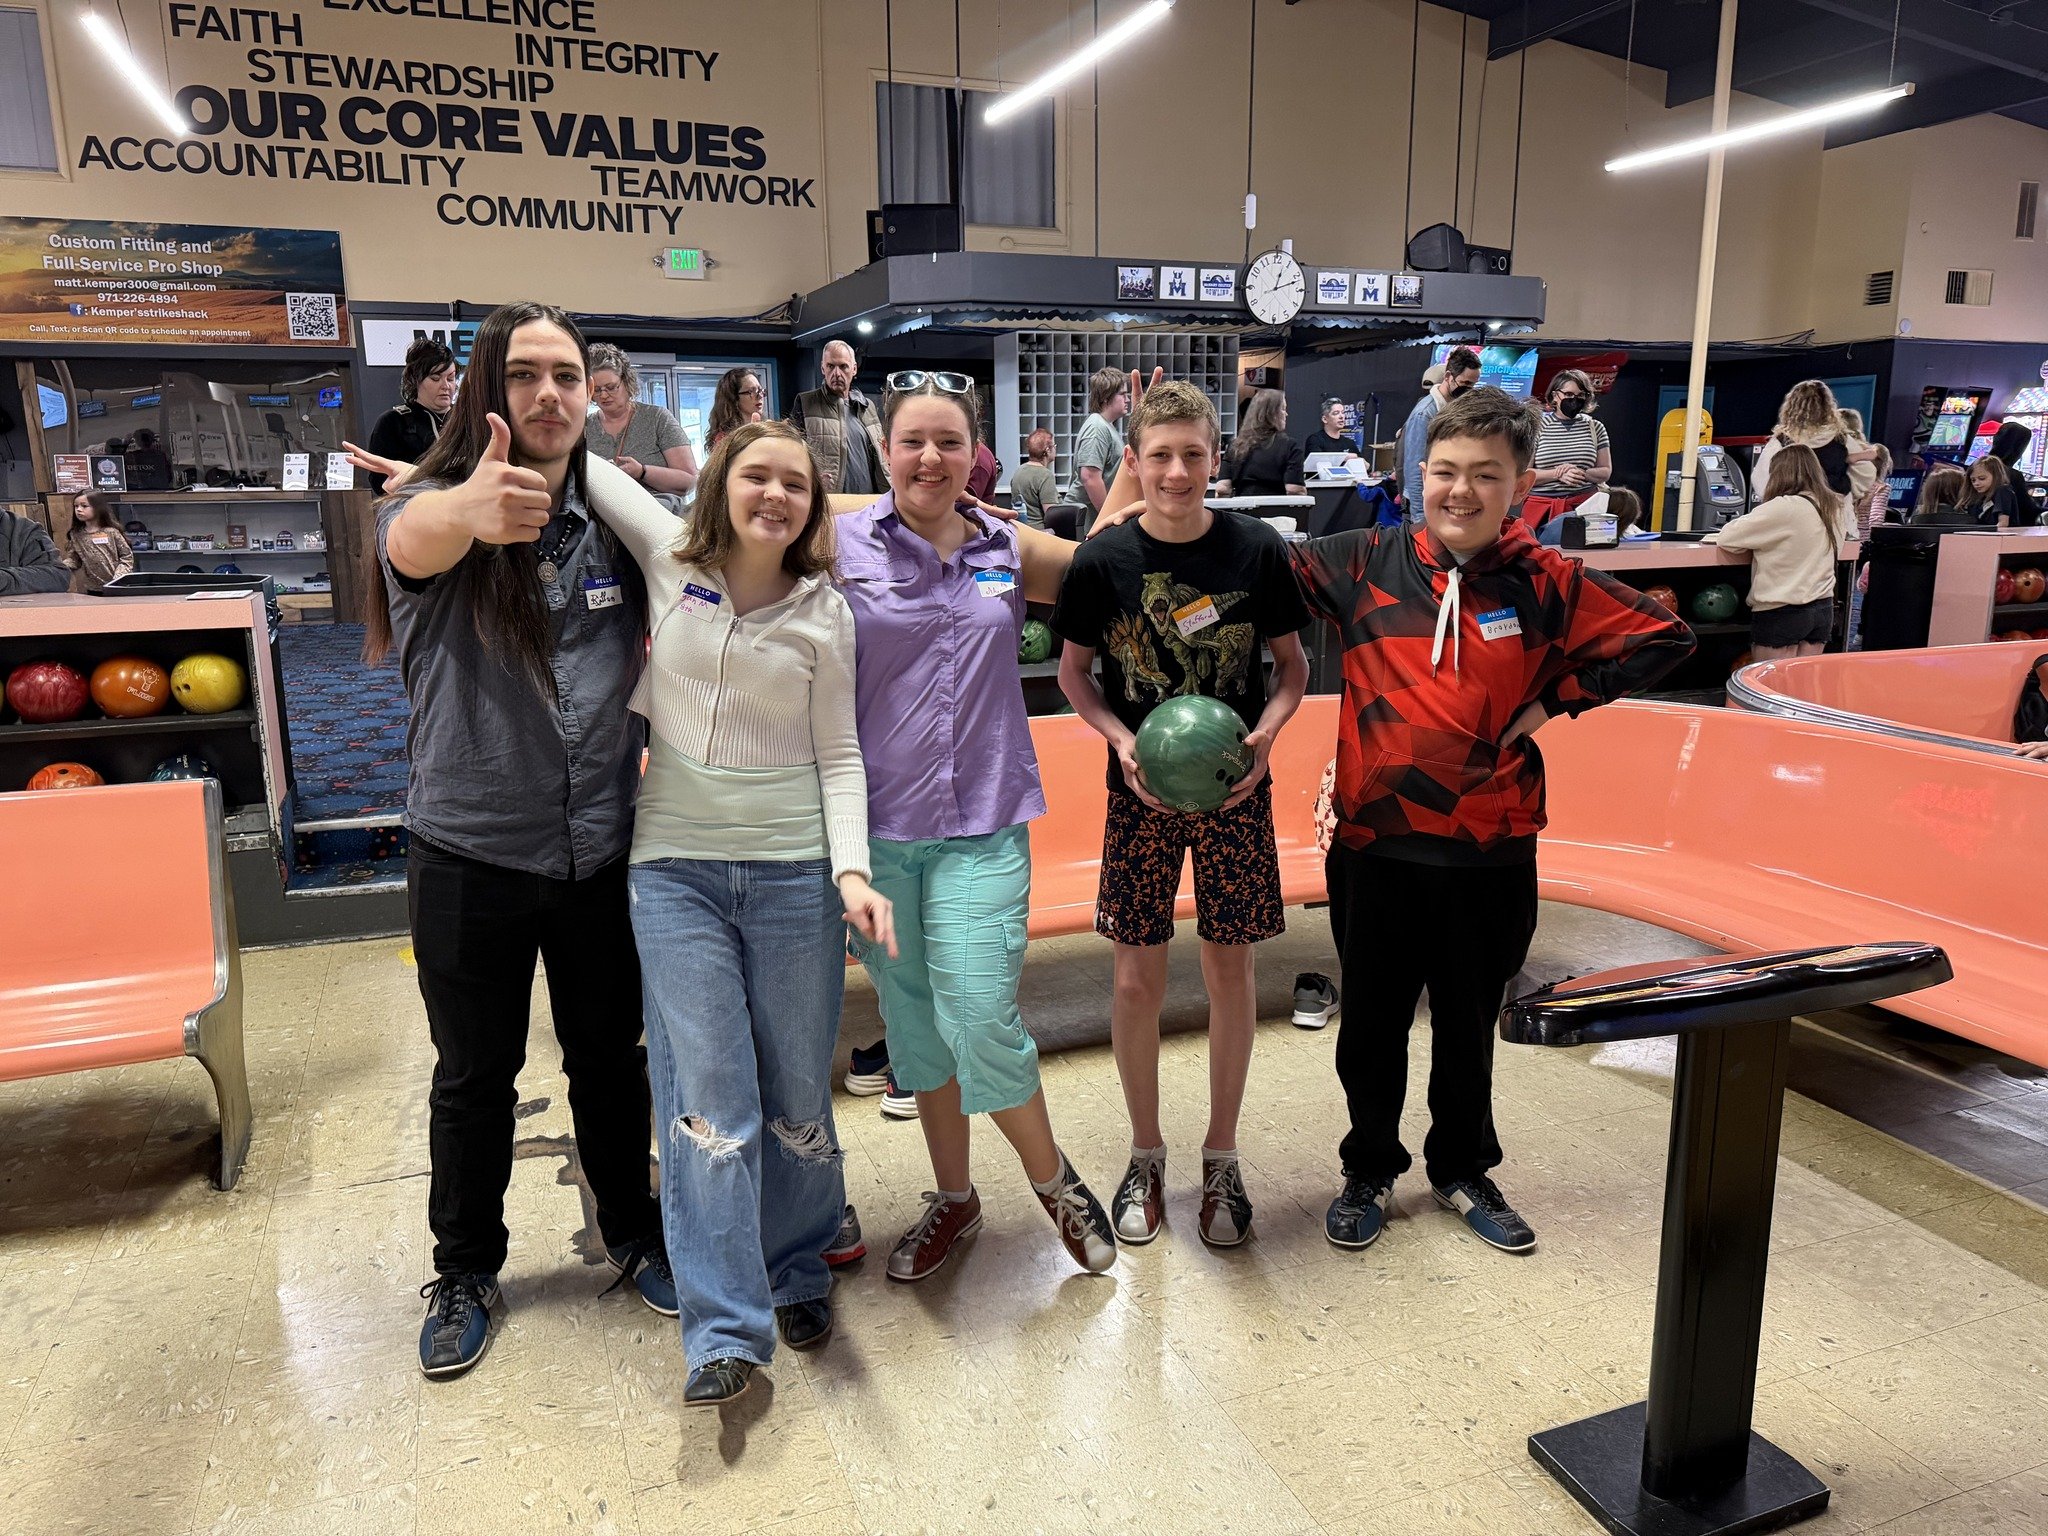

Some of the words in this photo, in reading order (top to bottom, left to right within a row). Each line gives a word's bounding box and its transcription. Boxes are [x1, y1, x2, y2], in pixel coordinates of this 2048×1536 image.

[323, 0, 596, 33] ELLENCE
[168, 2, 303, 47] FAITH
[515, 32, 719, 82] INTEGRITY
[247, 48, 554, 102] STEWARDSHIP
[174, 84, 329, 142] OUR
[338, 96, 523, 154] CORE
[530, 110, 767, 171] VALUES
[78, 135, 465, 188] ACCOUNTABILITY
[590, 165, 816, 208] TEAMWORK
[437, 193, 683, 235] COMMUNITY
[49, 233, 116, 250] Custom
[121, 236, 178, 255] Fitting
[181, 240, 213, 254] and
[671, 249, 698, 270] EXIT
[1260, 256, 1270, 268] 11
[1285, 260, 1292, 269] 1
[42, 255, 144, 273] Full-Service
[148, 259, 177, 274] Pro
[181, 260, 224, 278] Shop
[1251, 266, 1261, 279] 10
[1293, 271, 1301, 280] 2
[54, 278, 217, 293] matt.kemper300@gmail.com
[97, 292, 178, 304] 971-226-4894
[1260, 309, 1266, 317] 7
[1283, 310, 1290, 319] 5
[82, 325, 103, 333] Scan
[105, 326, 118, 334] QR
[119, 326, 139, 335] code
[140, 327, 150, 335] to
[151, 327, 187, 336] schedule
[201, 328, 251, 338] appointment
[1886, 477, 1916, 489] ARAOKE
[595, 576, 613, 585] HELLO
[690, 585, 711, 597] HELLO
[1182, 601, 1200, 613] HELLO
[1487, 610, 1506, 618] HELLO
